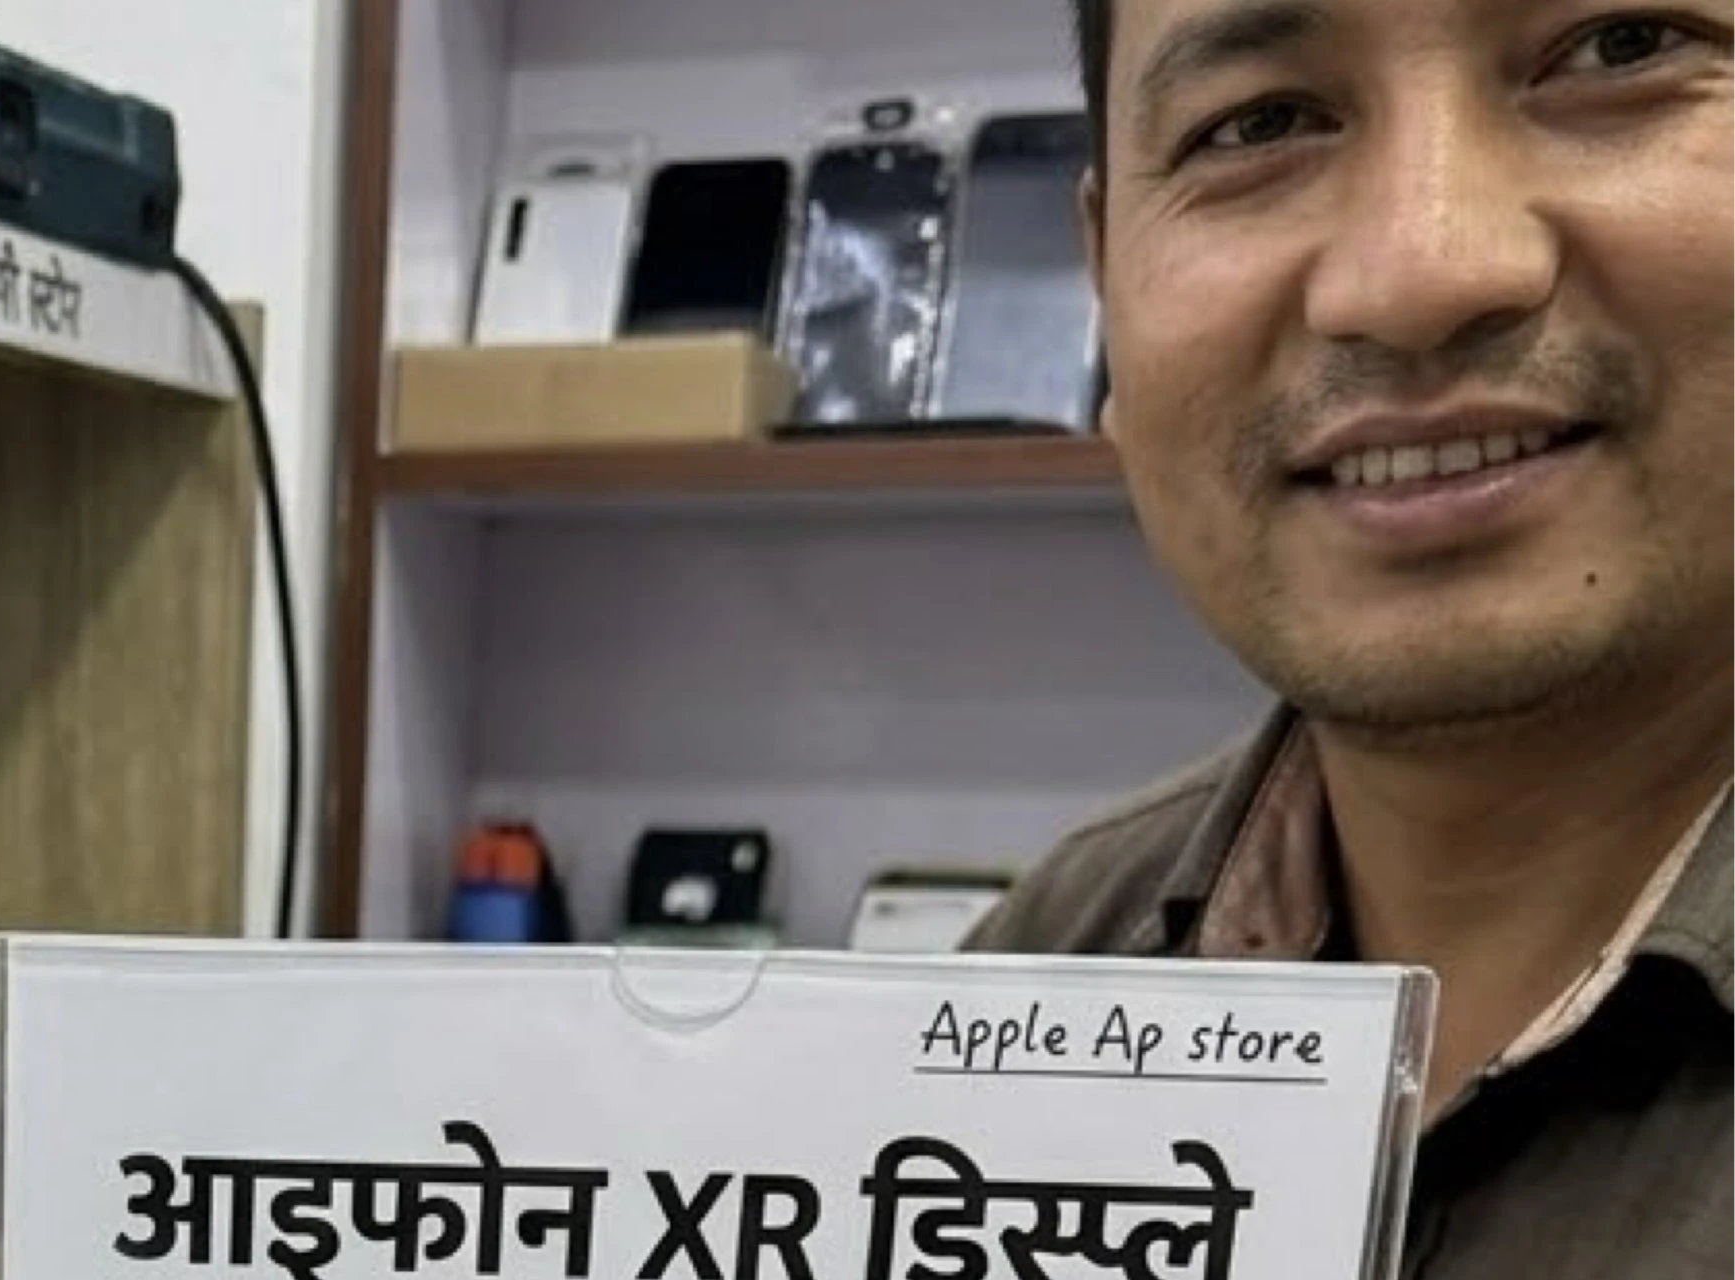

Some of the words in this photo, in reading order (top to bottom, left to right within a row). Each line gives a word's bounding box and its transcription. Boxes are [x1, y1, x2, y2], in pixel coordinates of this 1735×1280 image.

[921, 1000, 1066, 1067] Apple
[1092, 1004, 1163, 1073] Ap
[1187, 1012, 1322, 1064] store
